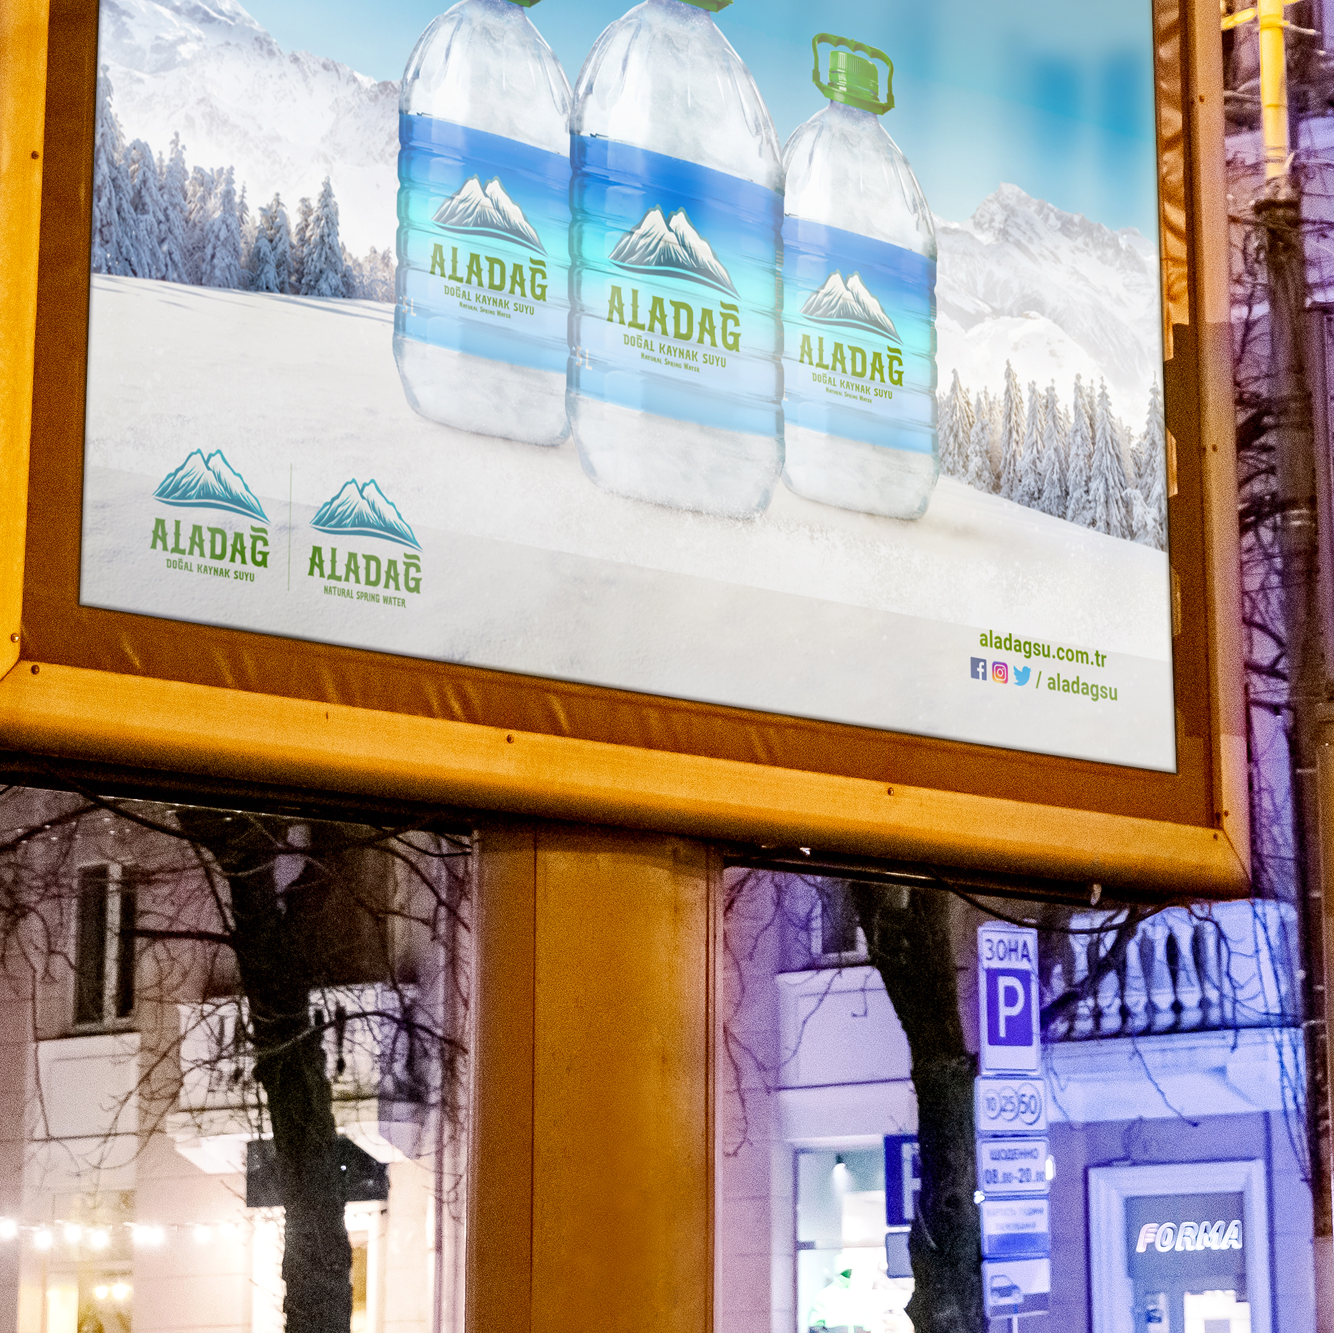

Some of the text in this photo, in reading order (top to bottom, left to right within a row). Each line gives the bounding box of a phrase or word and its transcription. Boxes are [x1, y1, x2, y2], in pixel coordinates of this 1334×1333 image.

[429, 242, 548, 302] ALADAĞ
[443, 284, 535, 316] DOĞAL KAYNAK SUYU
[606, 284, 742, 353] ALADAĞ
[623, 333, 727, 368] DOĞAL KAYNAK SUYU
[798, 333, 905, 387] ALADAĞ
[811, 372, 893, 400] DOĞAL KAYNAK SUYU
[150, 517, 270, 568] ALADAĞ
[165, 558, 255, 582] DOĞAL KAYNAK SUYU
[307, 545, 423, 594] ALADAĞ
[323, 585, 406, 608] NATURAL SPRING WATER
[979, 629, 1107, 668] aladagsu.com.tr
[1047, 672, 1118, 702] aladagsu
[997, 975, 1025, 1038] P
[1135, 1219, 1243, 1253] FORMA
